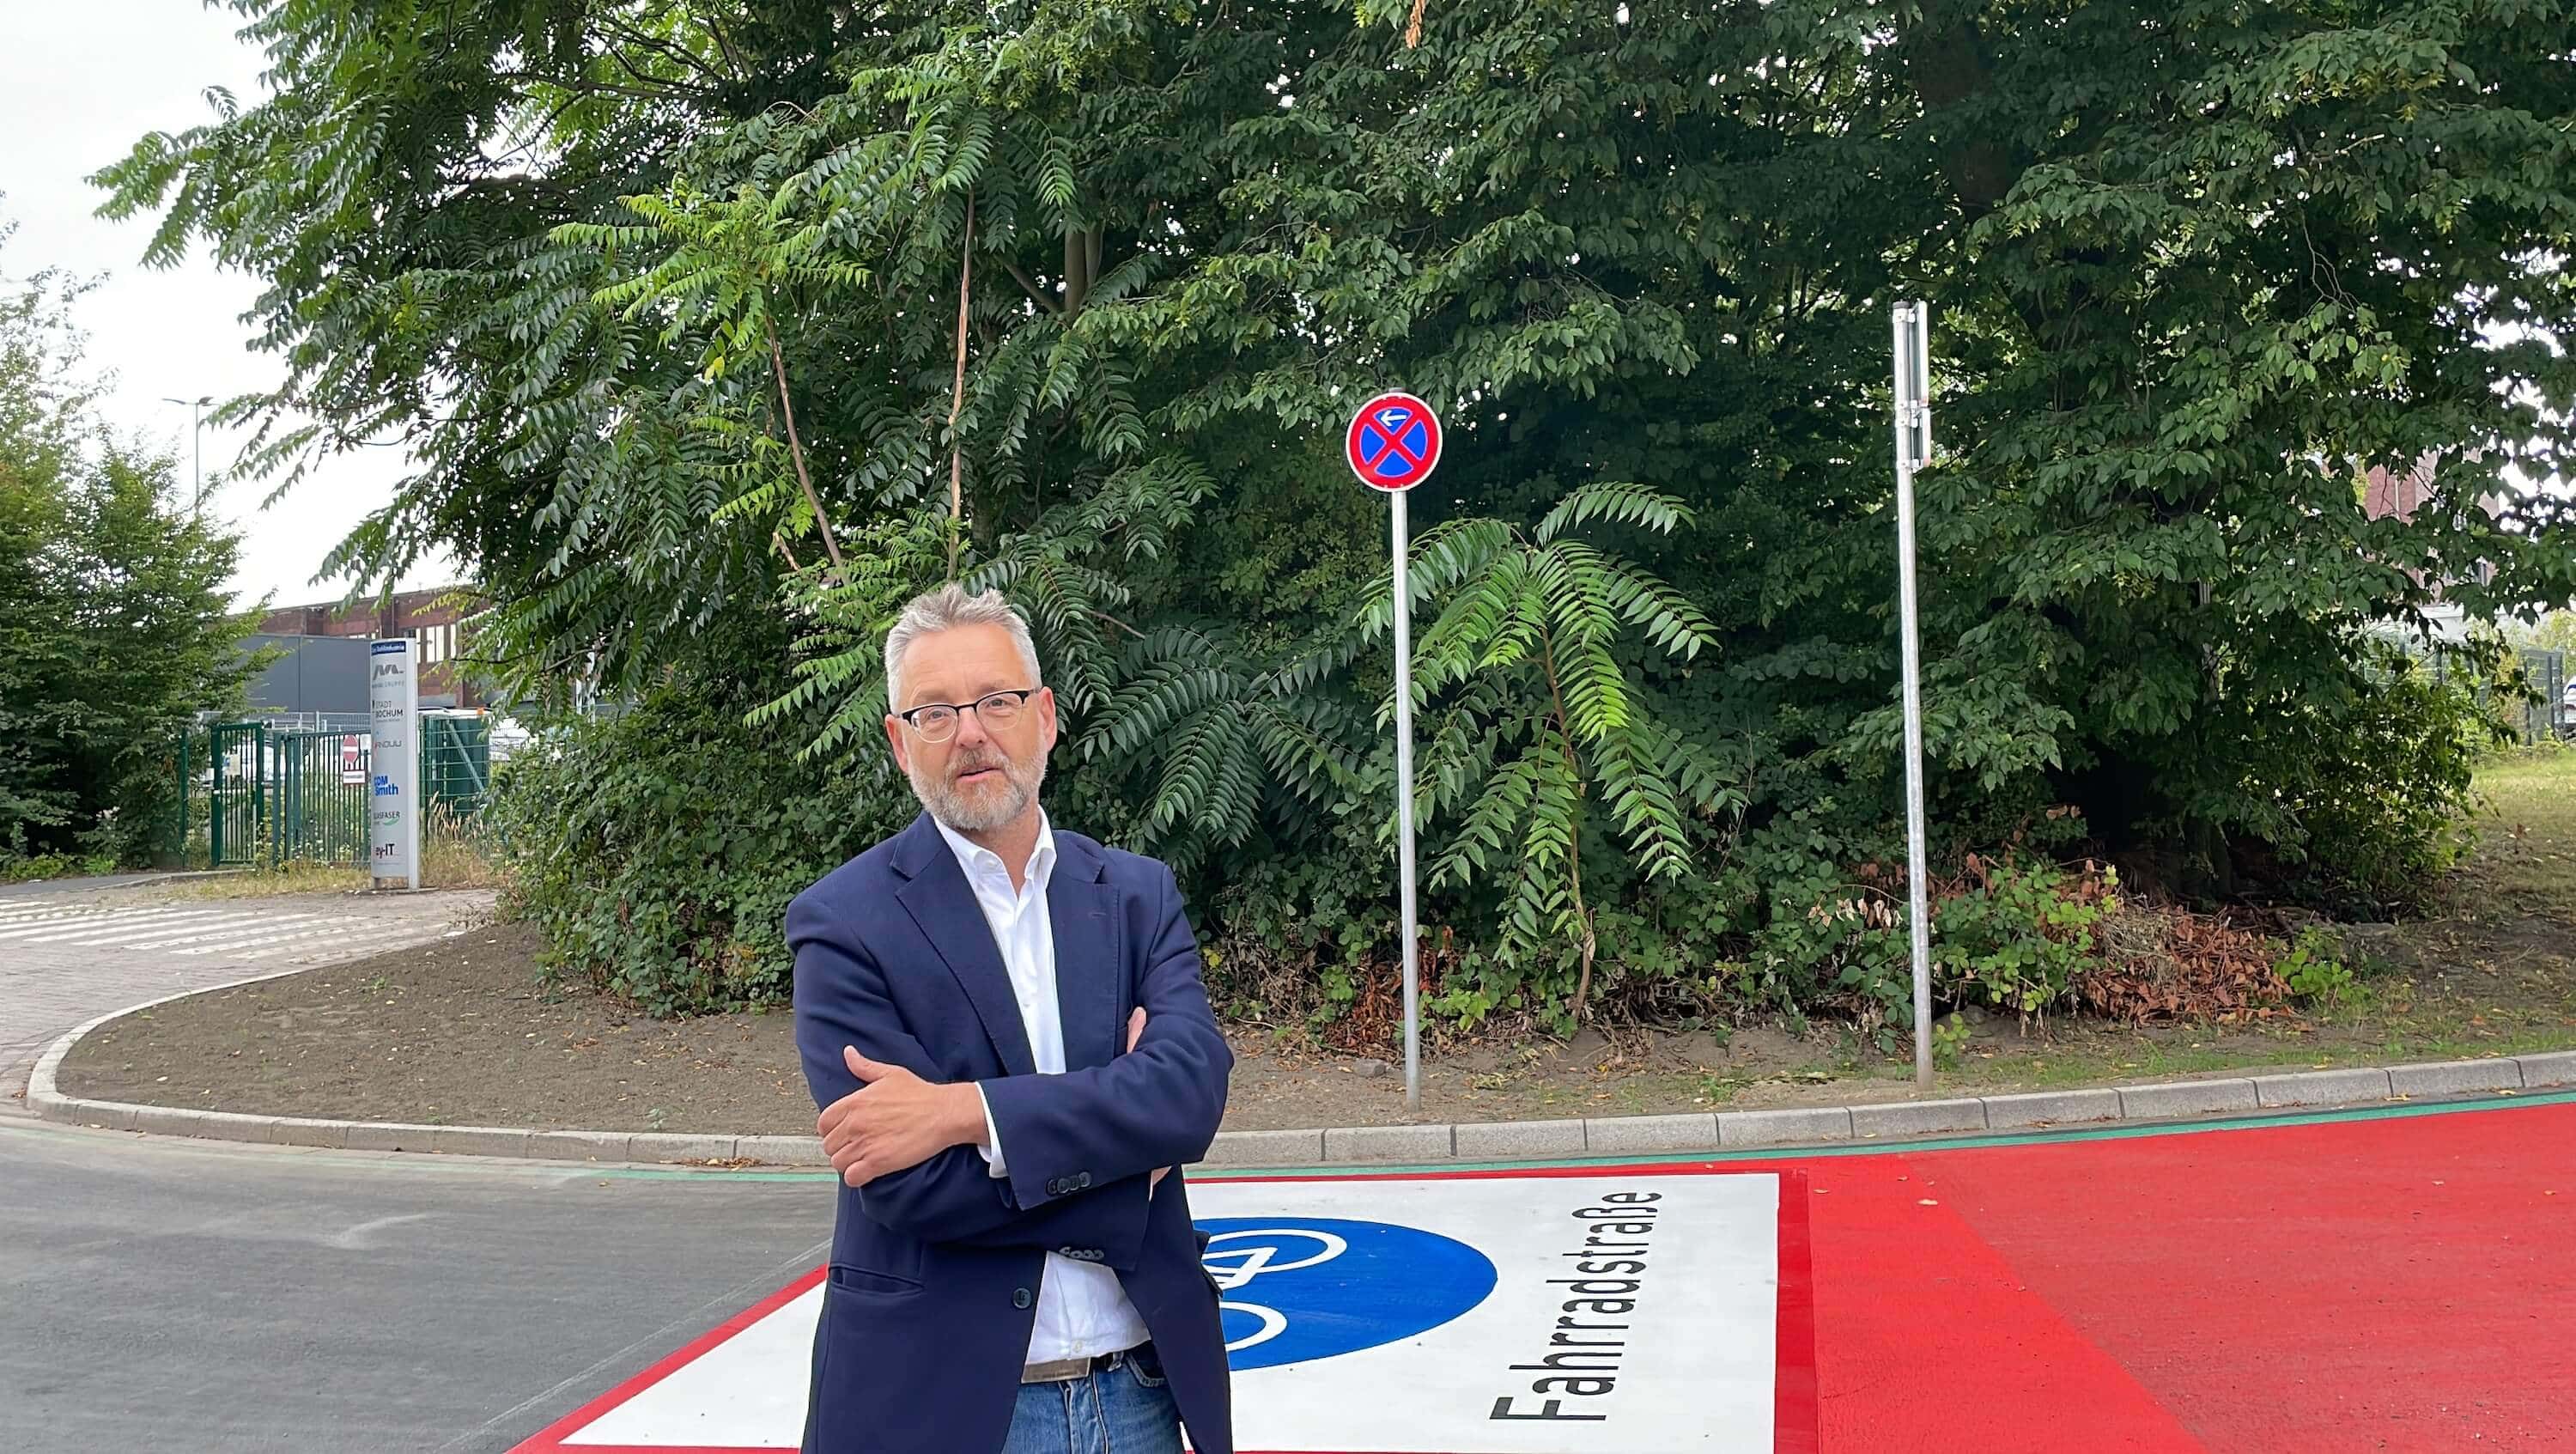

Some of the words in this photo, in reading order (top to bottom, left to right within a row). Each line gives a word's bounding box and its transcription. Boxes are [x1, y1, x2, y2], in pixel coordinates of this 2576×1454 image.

[376, 709, 404, 718] BOCHUM
[375, 783, 398, 796] Smith
[1489, 1191, 1662, 1421] Fahrradstraße
